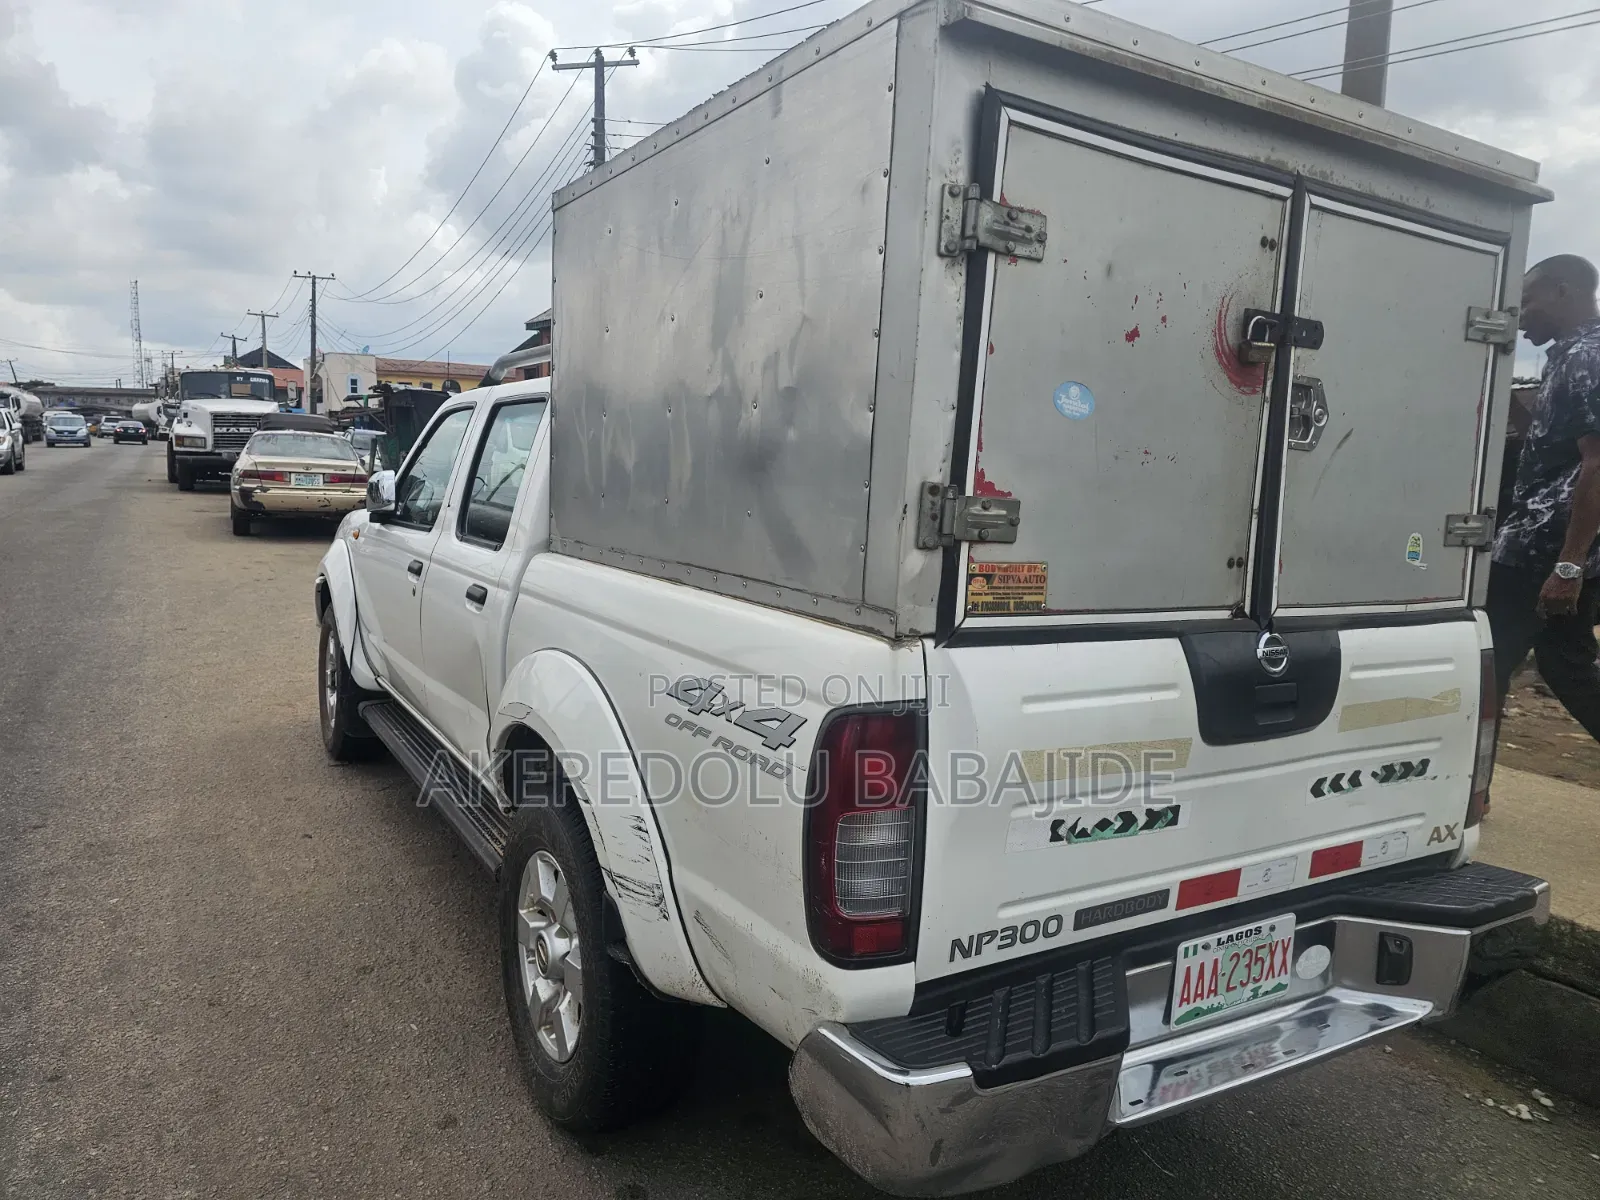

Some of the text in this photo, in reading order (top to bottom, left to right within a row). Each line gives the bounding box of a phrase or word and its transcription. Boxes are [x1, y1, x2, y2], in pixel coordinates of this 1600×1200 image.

[1022, 575, 1046, 584] AUTO
[664, 712, 792, 780] OFF ROAD
[1426, 822, 1460, 847] AX
[948, 891, 1168, 963] NP300 HARDBODY
[1216, 926, 1262, 947] LAGOS
[1179, 937, 1292, 1007] AAA-235XX
